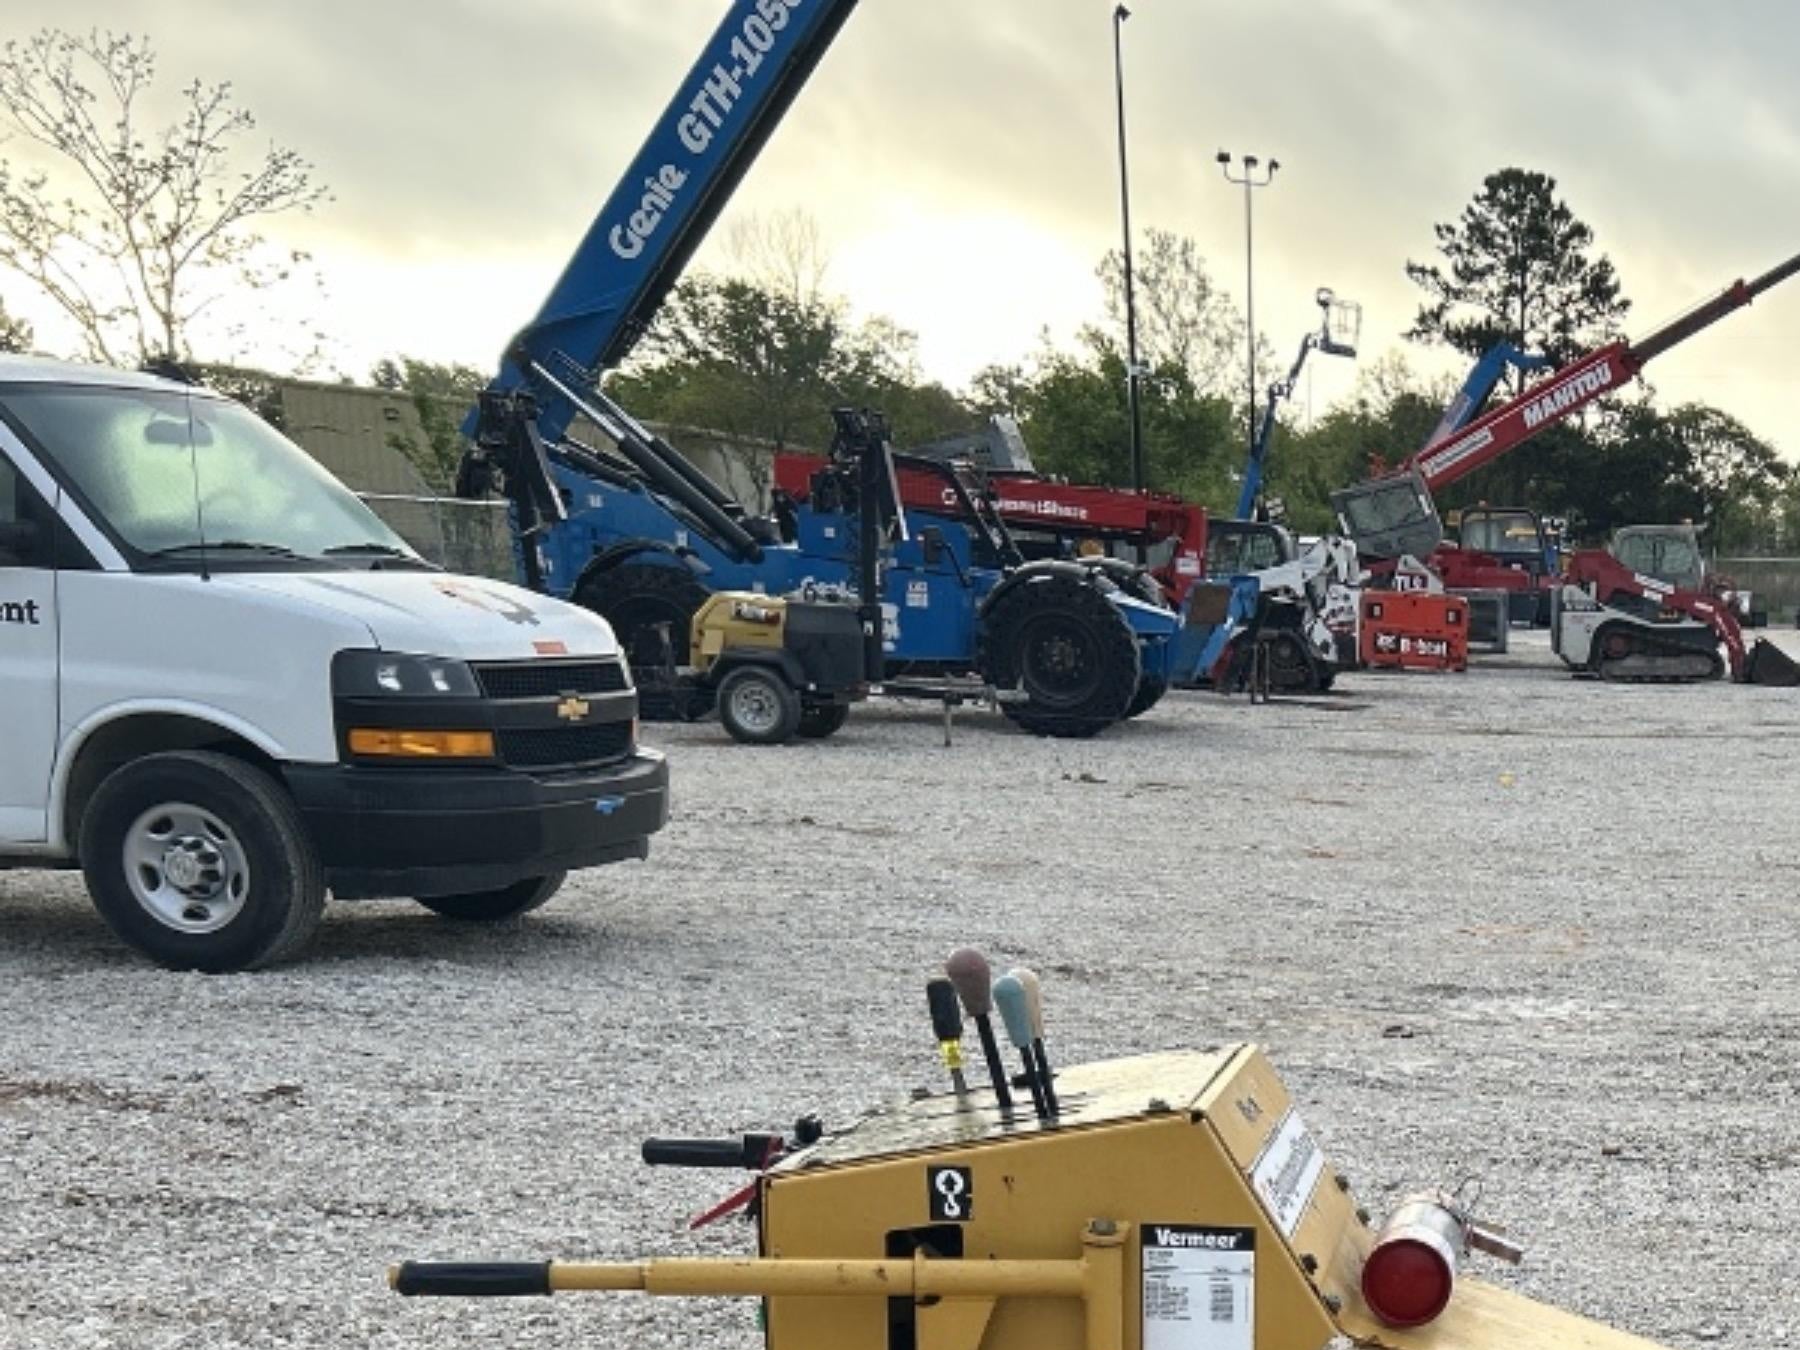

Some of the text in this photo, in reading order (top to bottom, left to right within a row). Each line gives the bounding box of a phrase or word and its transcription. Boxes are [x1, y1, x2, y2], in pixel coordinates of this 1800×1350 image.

[608, 0, 800, 259] Genie GTH-105
[1523, 361, 1612, 429] MANITOU
[1155, 1226, 1238, 1249] Vermeer
